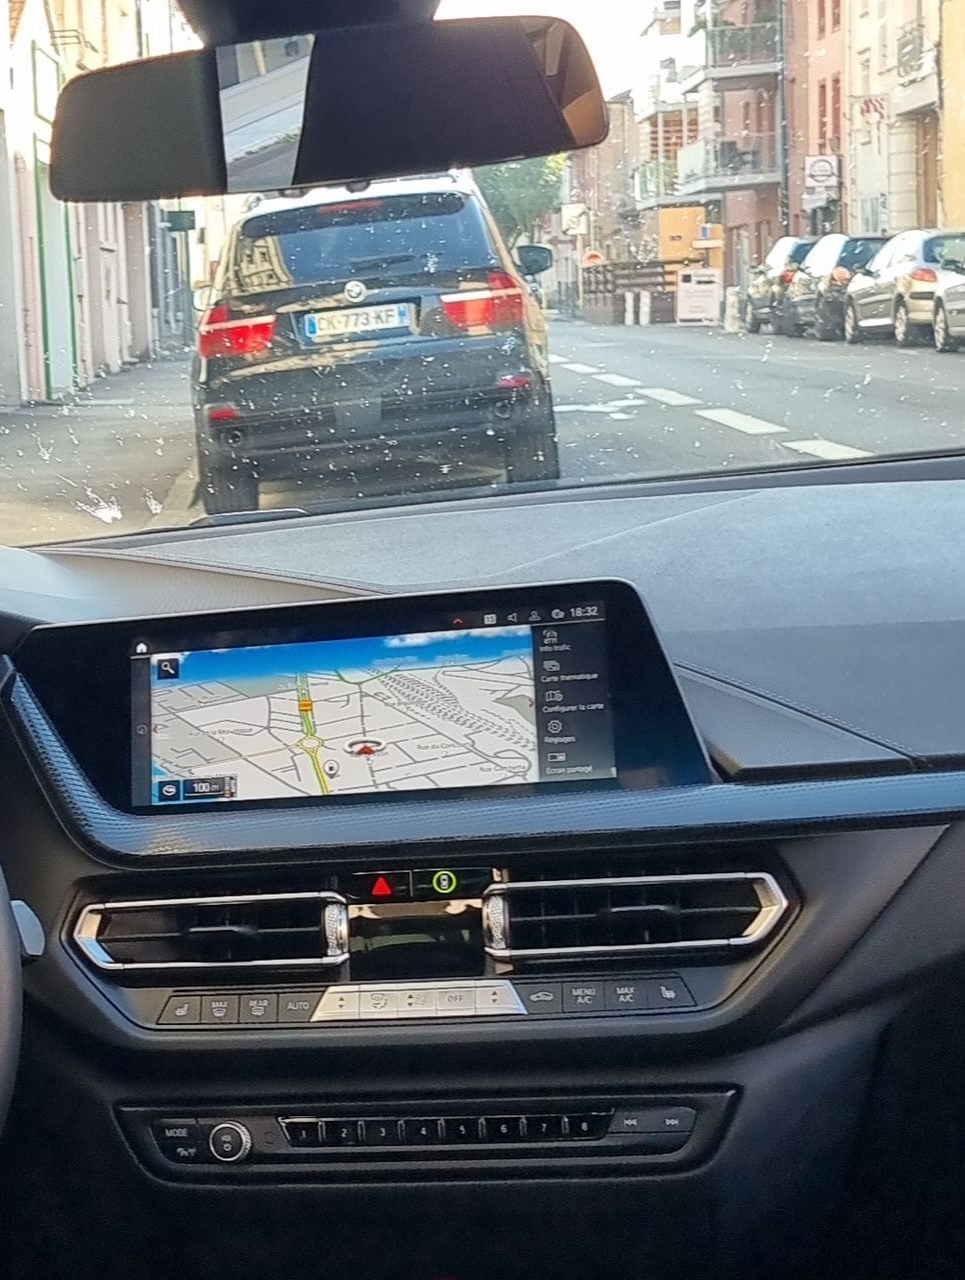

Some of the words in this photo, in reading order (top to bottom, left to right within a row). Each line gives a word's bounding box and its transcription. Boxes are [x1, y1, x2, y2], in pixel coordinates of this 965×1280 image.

[570, 606, 598, 617] 18:32
[192, 782, 210, 793] 100
[210, 784, 219, 792] m
[572, 988, 596, 996] MENU
[616, 986, 634, 994] MAX
[249, 999, 268, 1007] REAR
[447, 994, 464, 1003] OFF
[576, 996, 593, 1004] A/C
[618, 994, 634, 1003] A/C
[286, 1002, 309, 1010] AUTO
[420, 1127, 427, 1135] 4
[459, 1126, 466, 1134] 5
[500, 1124, 508, 1133] 6
[541, 1123, 547, 1132] 7
[581, 1122, 588, 1131] 8
[165, 1128, 188, 1137] MODE
[301, 1130, 307, 1138] 1
[340, 1128, 347, 1137] 2
[379, 1128, 386, 1137] 3
